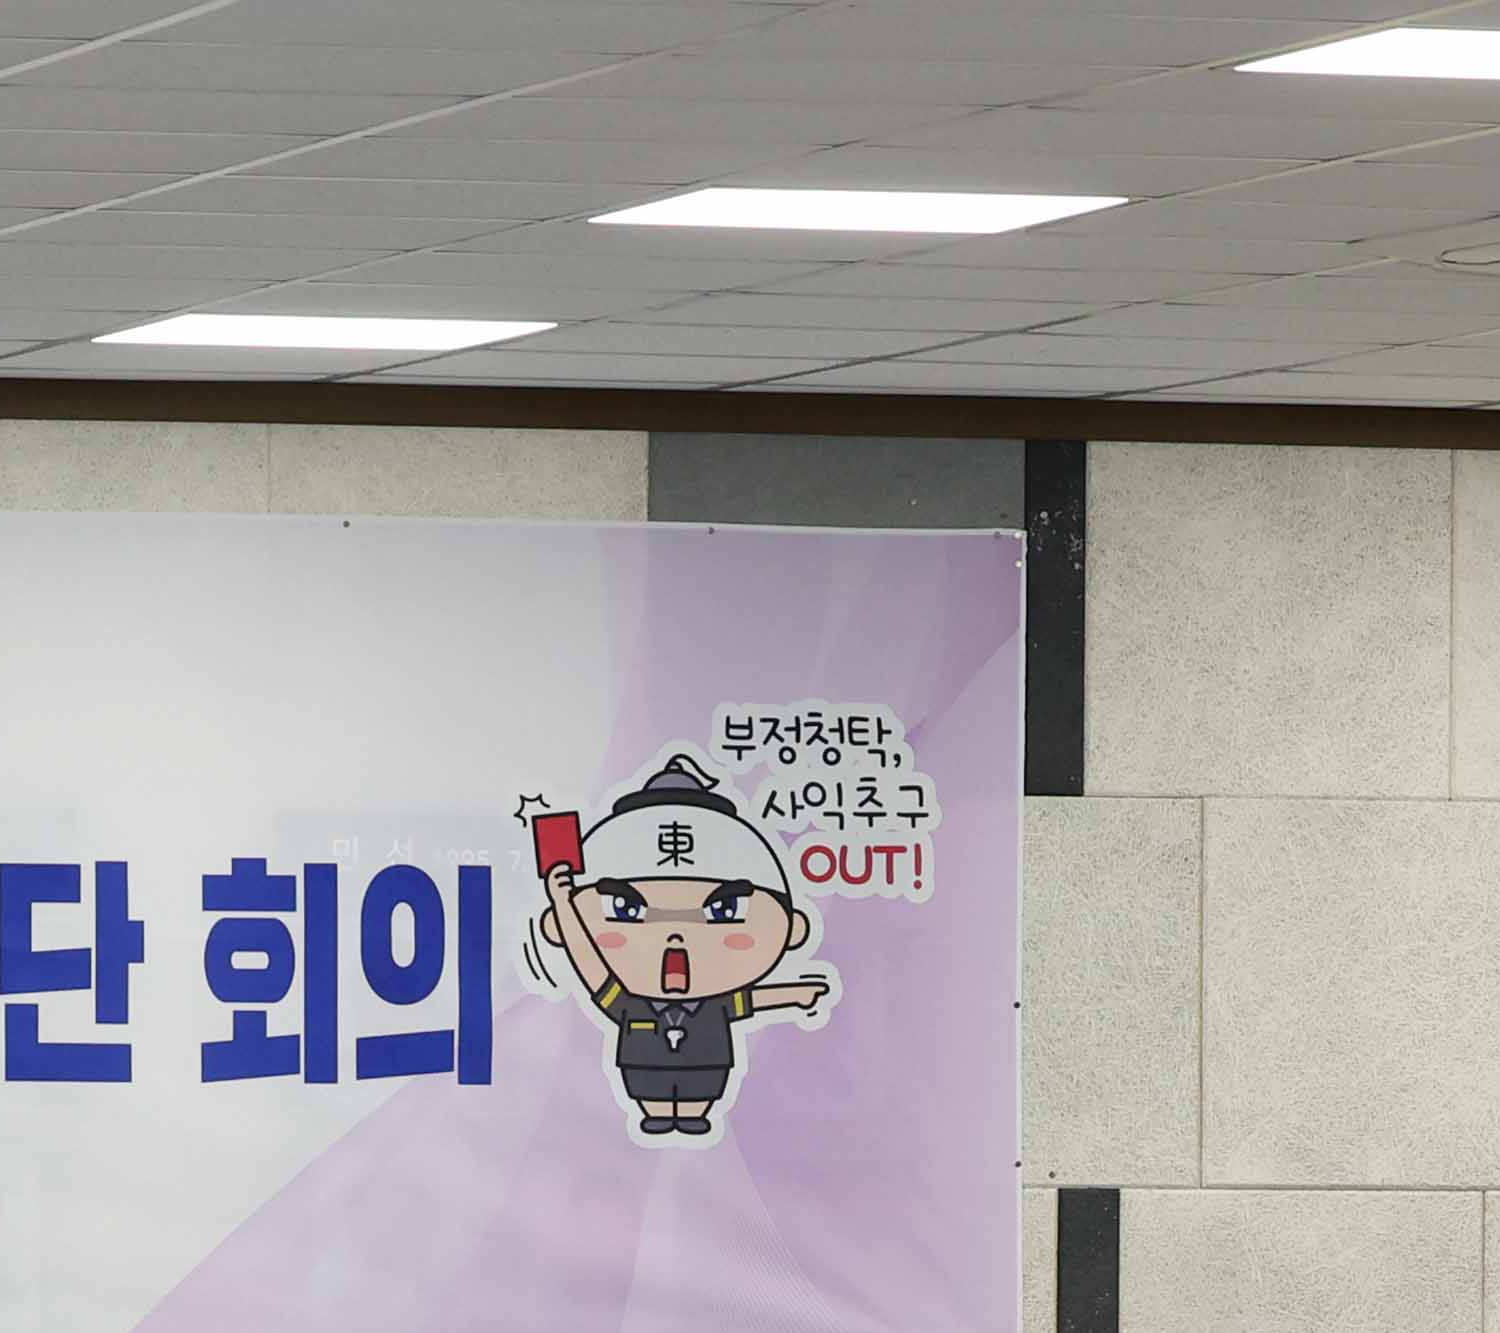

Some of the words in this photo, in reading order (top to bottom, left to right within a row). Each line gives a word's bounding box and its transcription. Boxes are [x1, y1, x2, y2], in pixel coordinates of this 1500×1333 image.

[721, 711, 902, 768] 부정청탁,
[761, 777, 929, 832] 사익추구
[656, 820, 695, 867] 東
[799, 843, 923, 890] OUT!
[202, 857, 494, 1087] 회의
